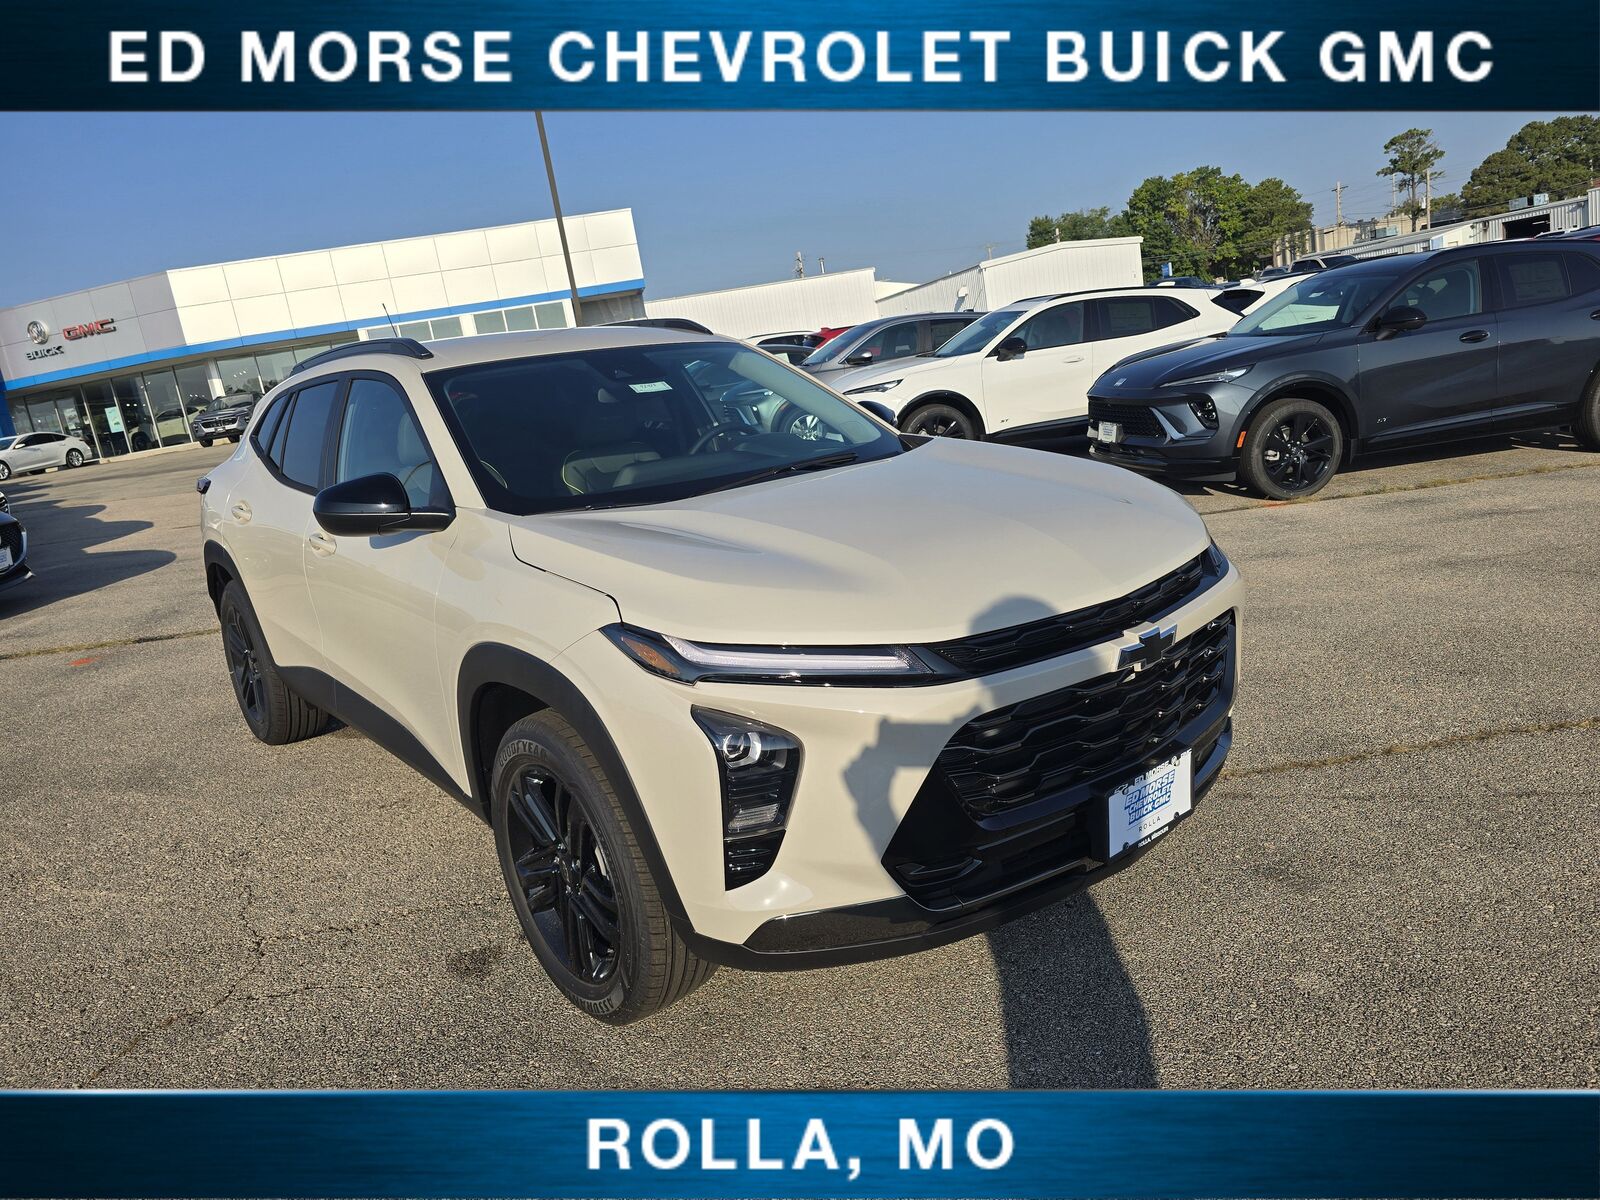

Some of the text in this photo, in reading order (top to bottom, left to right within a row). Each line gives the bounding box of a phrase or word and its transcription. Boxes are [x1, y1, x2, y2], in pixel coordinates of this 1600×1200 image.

[63, 318, 117, 341] GMC
[26, 345, 65, 361] BUICK
[1125, 770, 1175, 807] ED MORSE
[1129, 785, 1171, 814] CHEVROLET
[1138, 816, 1161, 832] ROLLA
